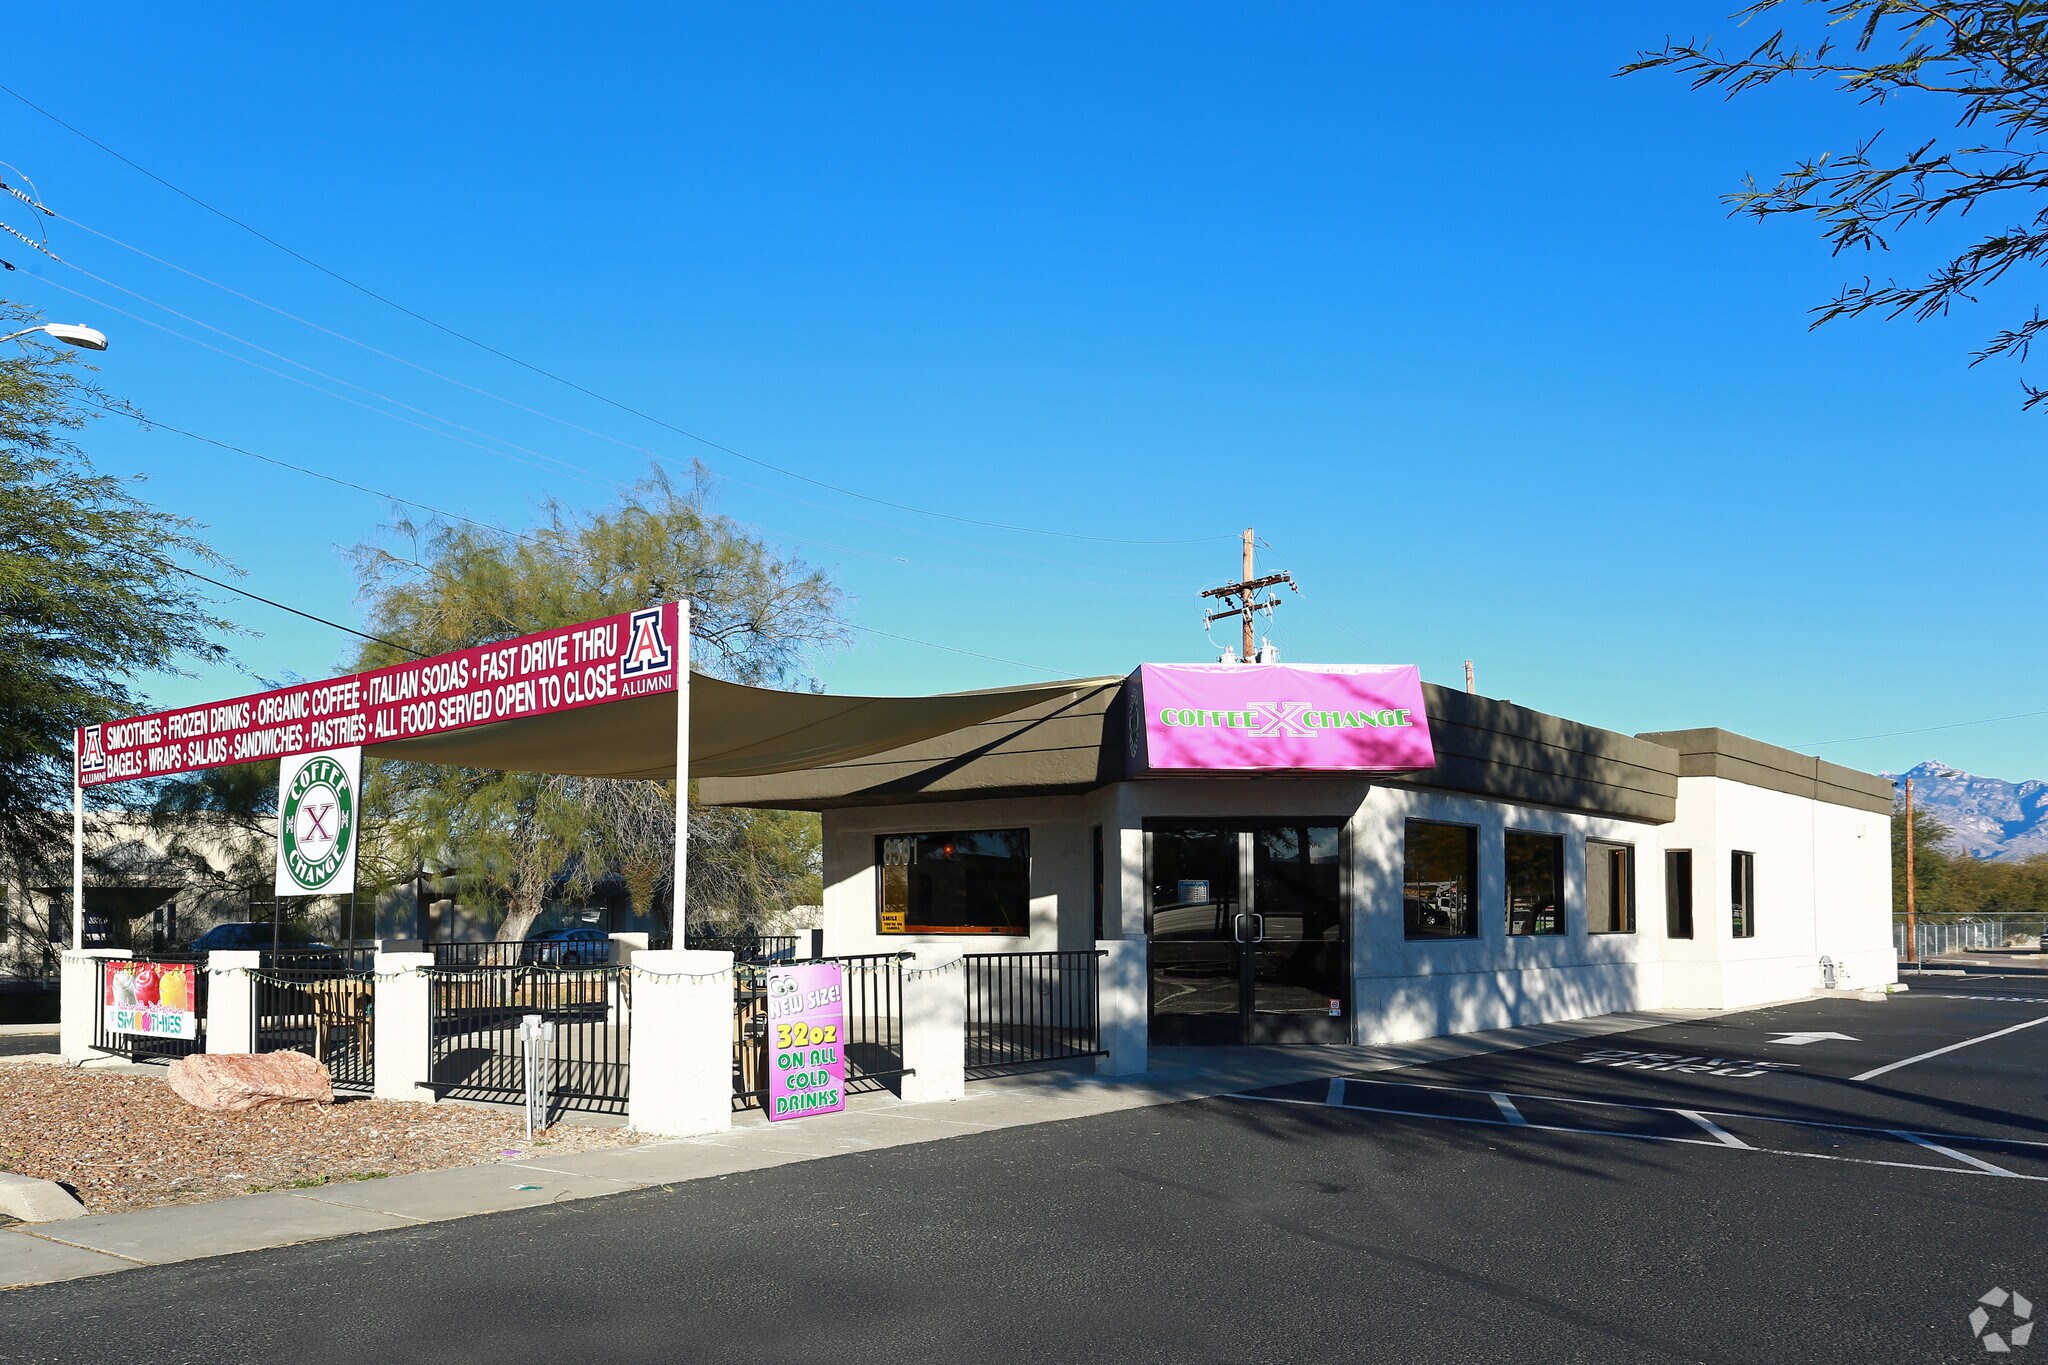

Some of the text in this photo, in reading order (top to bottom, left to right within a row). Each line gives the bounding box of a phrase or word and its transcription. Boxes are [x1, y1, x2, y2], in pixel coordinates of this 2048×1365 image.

[106, 623, 618, 750] SMOOTHIES FROZEN DRINKS ORGANIC COFFEE ITALIAN SODAS FAST DRIVE THRU
[620, 674, 672, 697] ALUMNI
[106, 662, 617, 778] BAGELS WRAPS SALADS SANDWICHES PASTRIES ALL FOOD SERVED OPEN TO CLOSE
[1159, 707, 1260, 730] COFFEE
[1301, 708, 1414, 730] CHANGE
[81, 771, 106, 785] ALUMNI
[291, 762, 348, 801] COFFEE
[300, 802, 335, 843] X
[289, 843, 344, 883] CHANGE
[769, 984, 841, 1019] NEW SIZE!
[117, 1011, 182, 1034] SMOOTHIES
[777, 1047, 838, 1071] ON ALL
[1582, 1050, 1801, 1071] DRIVE
[786, 1068, 830, 1091] COLD
[776, 1088, 839, 1115] DRINKS
